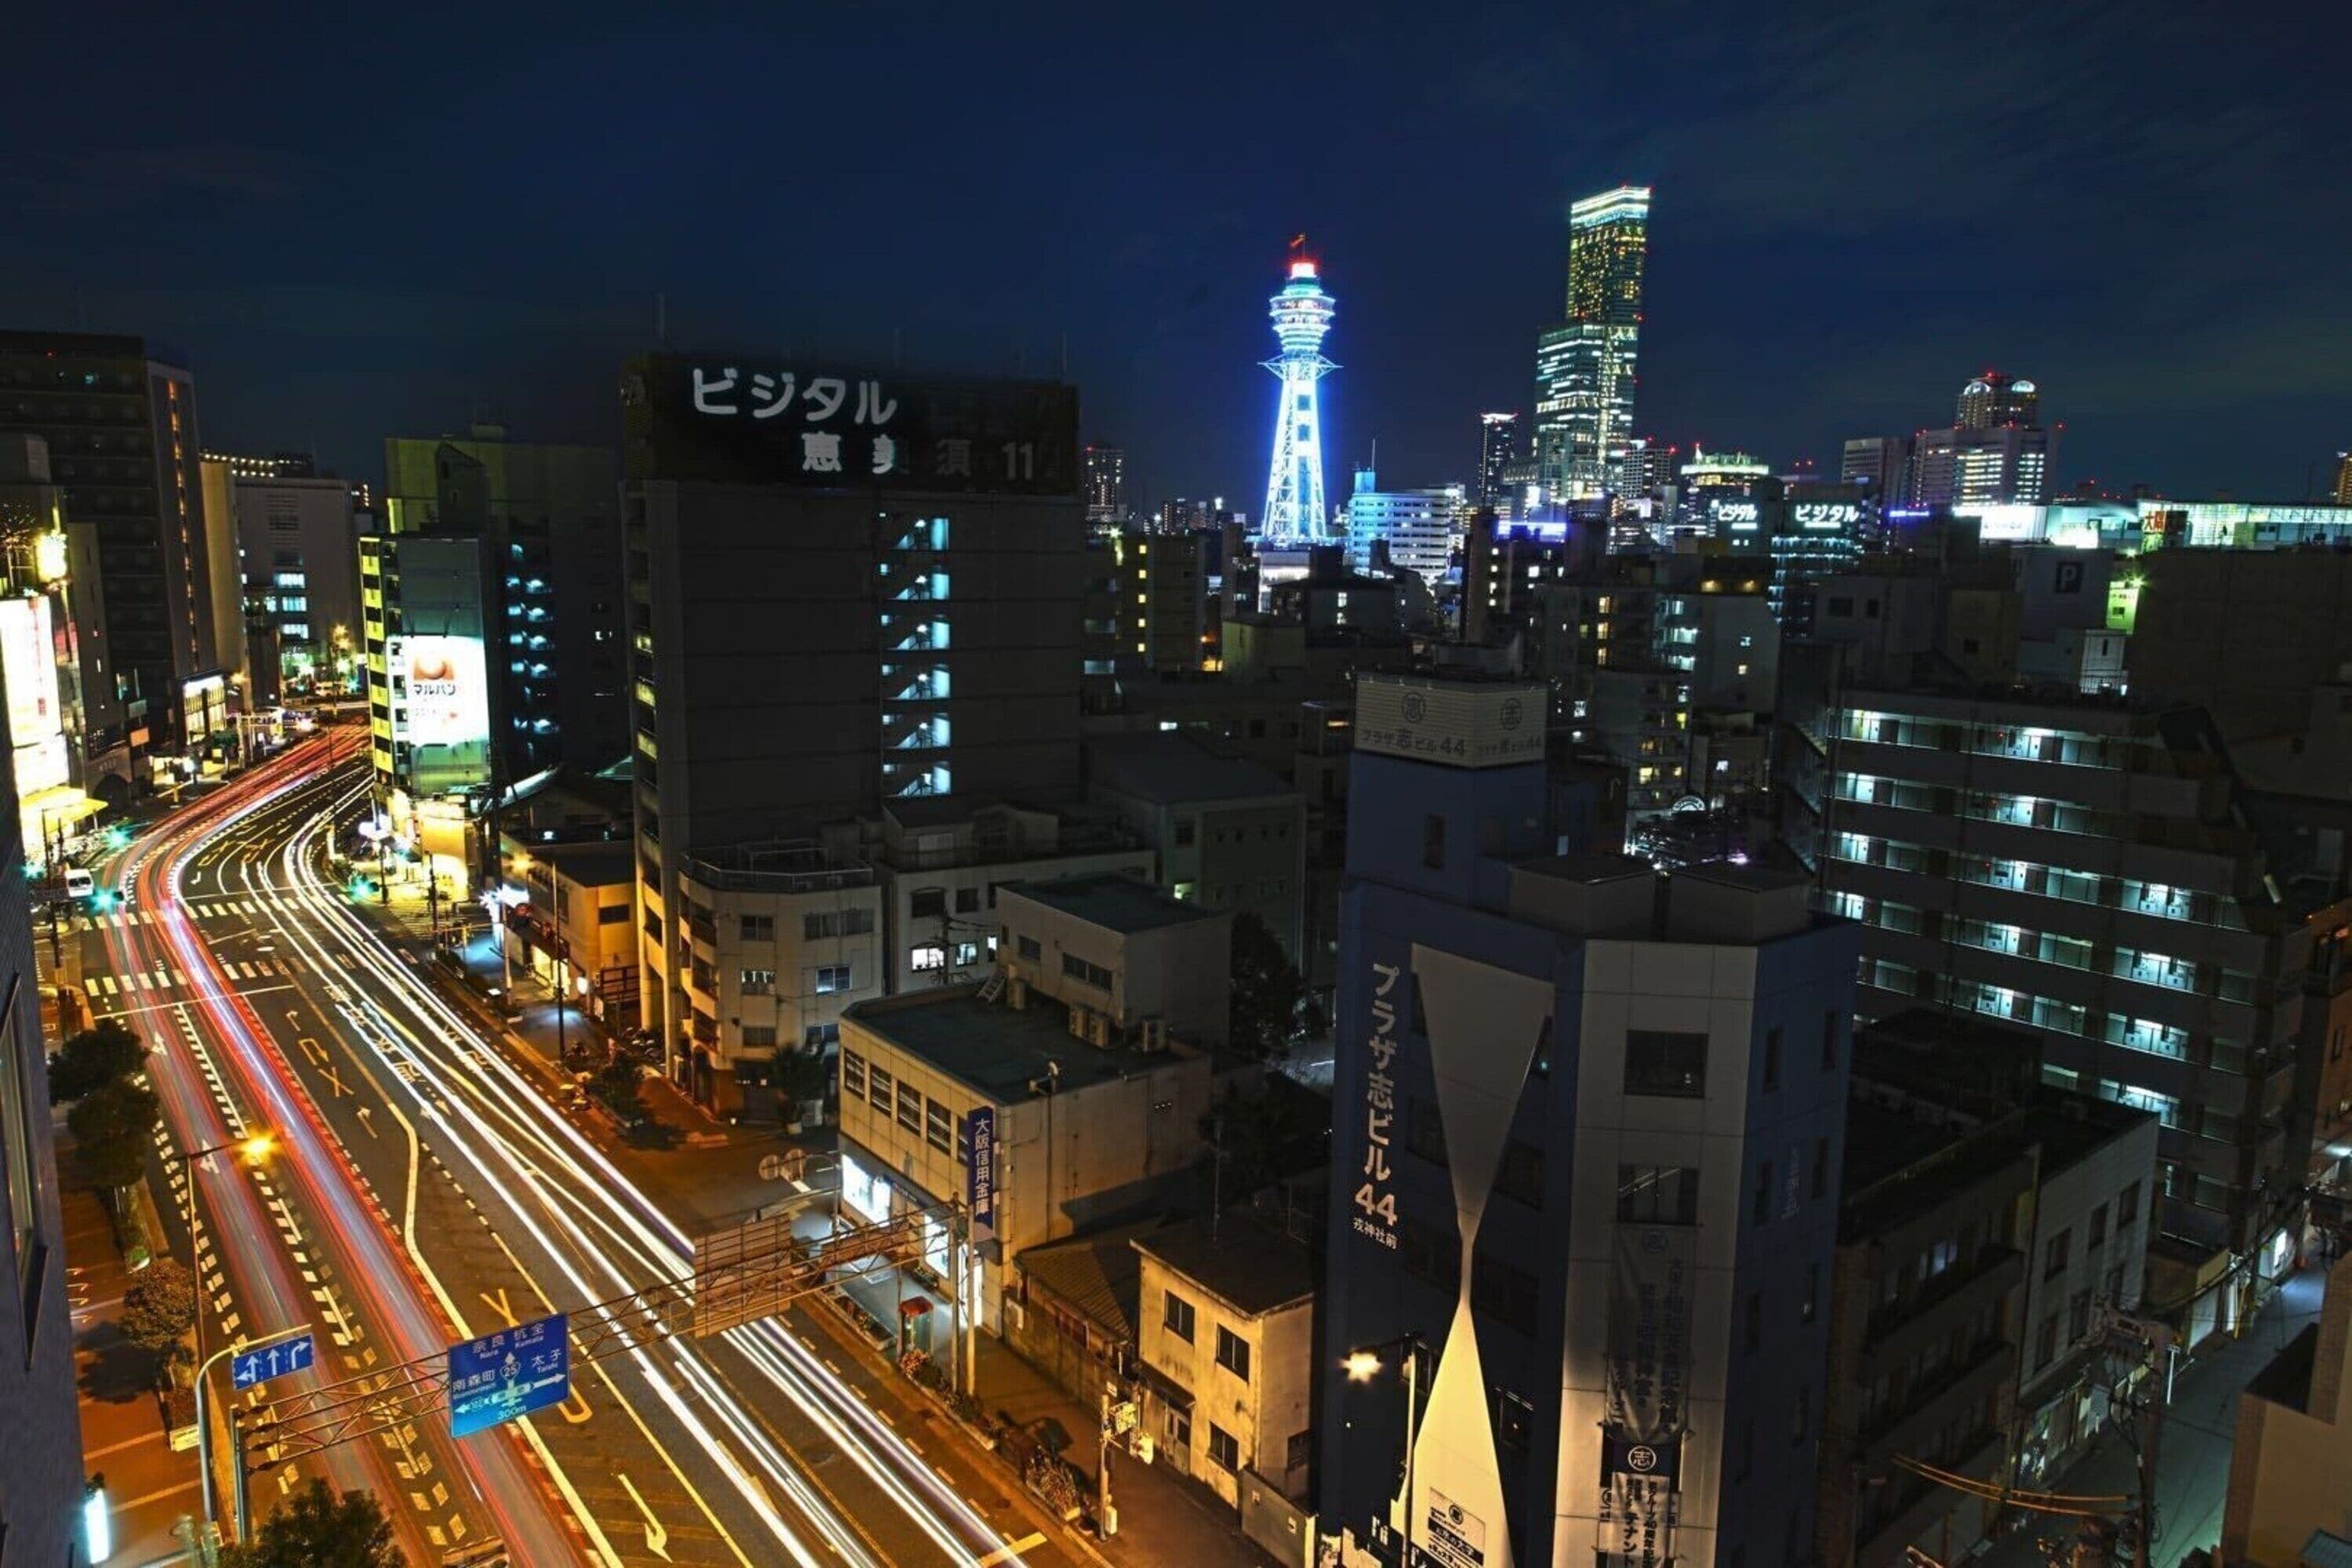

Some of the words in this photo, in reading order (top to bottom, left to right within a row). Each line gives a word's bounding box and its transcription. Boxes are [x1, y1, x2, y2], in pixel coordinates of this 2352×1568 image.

[692, 368, 898, 426] ビジタル
[975, 1117, 991, 1216] 大阪信用金庫
